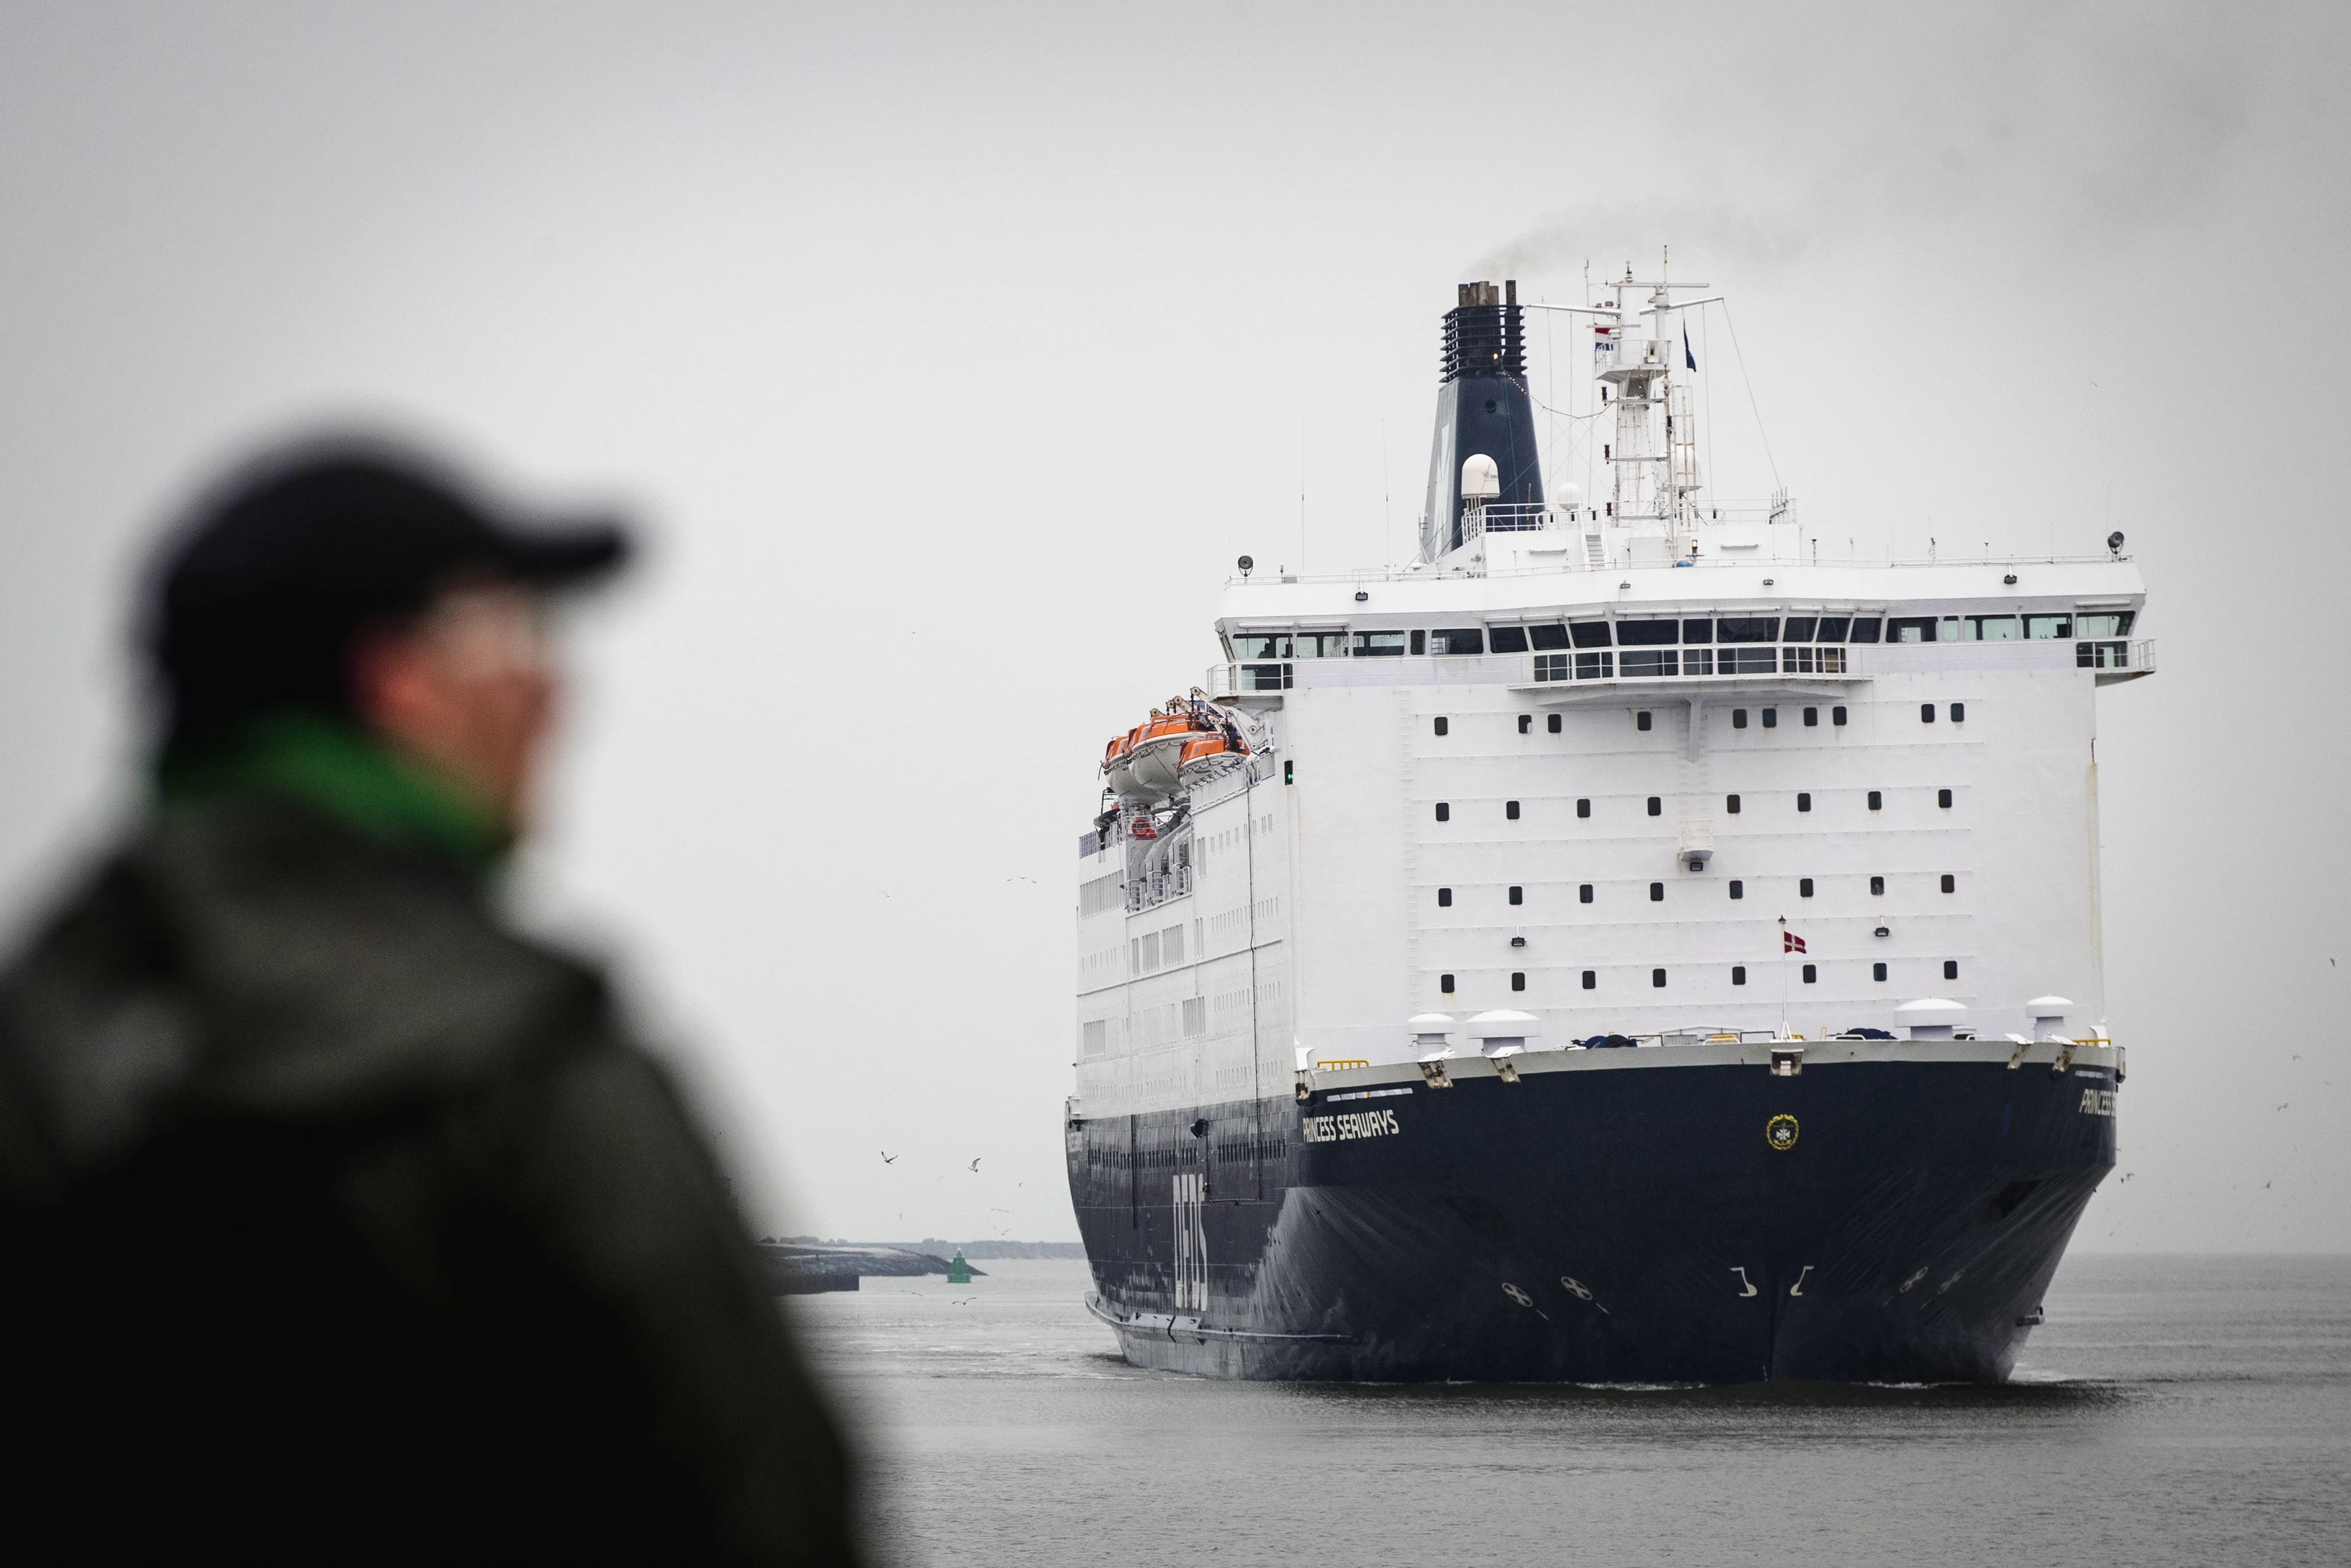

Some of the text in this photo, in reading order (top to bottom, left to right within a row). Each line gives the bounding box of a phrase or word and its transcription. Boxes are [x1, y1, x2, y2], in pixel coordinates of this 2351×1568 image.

[1303, 1109, 1400, 1142] PRINCESS SEAWAYS
[1172, 1174, 1208, 1311] DFDS
